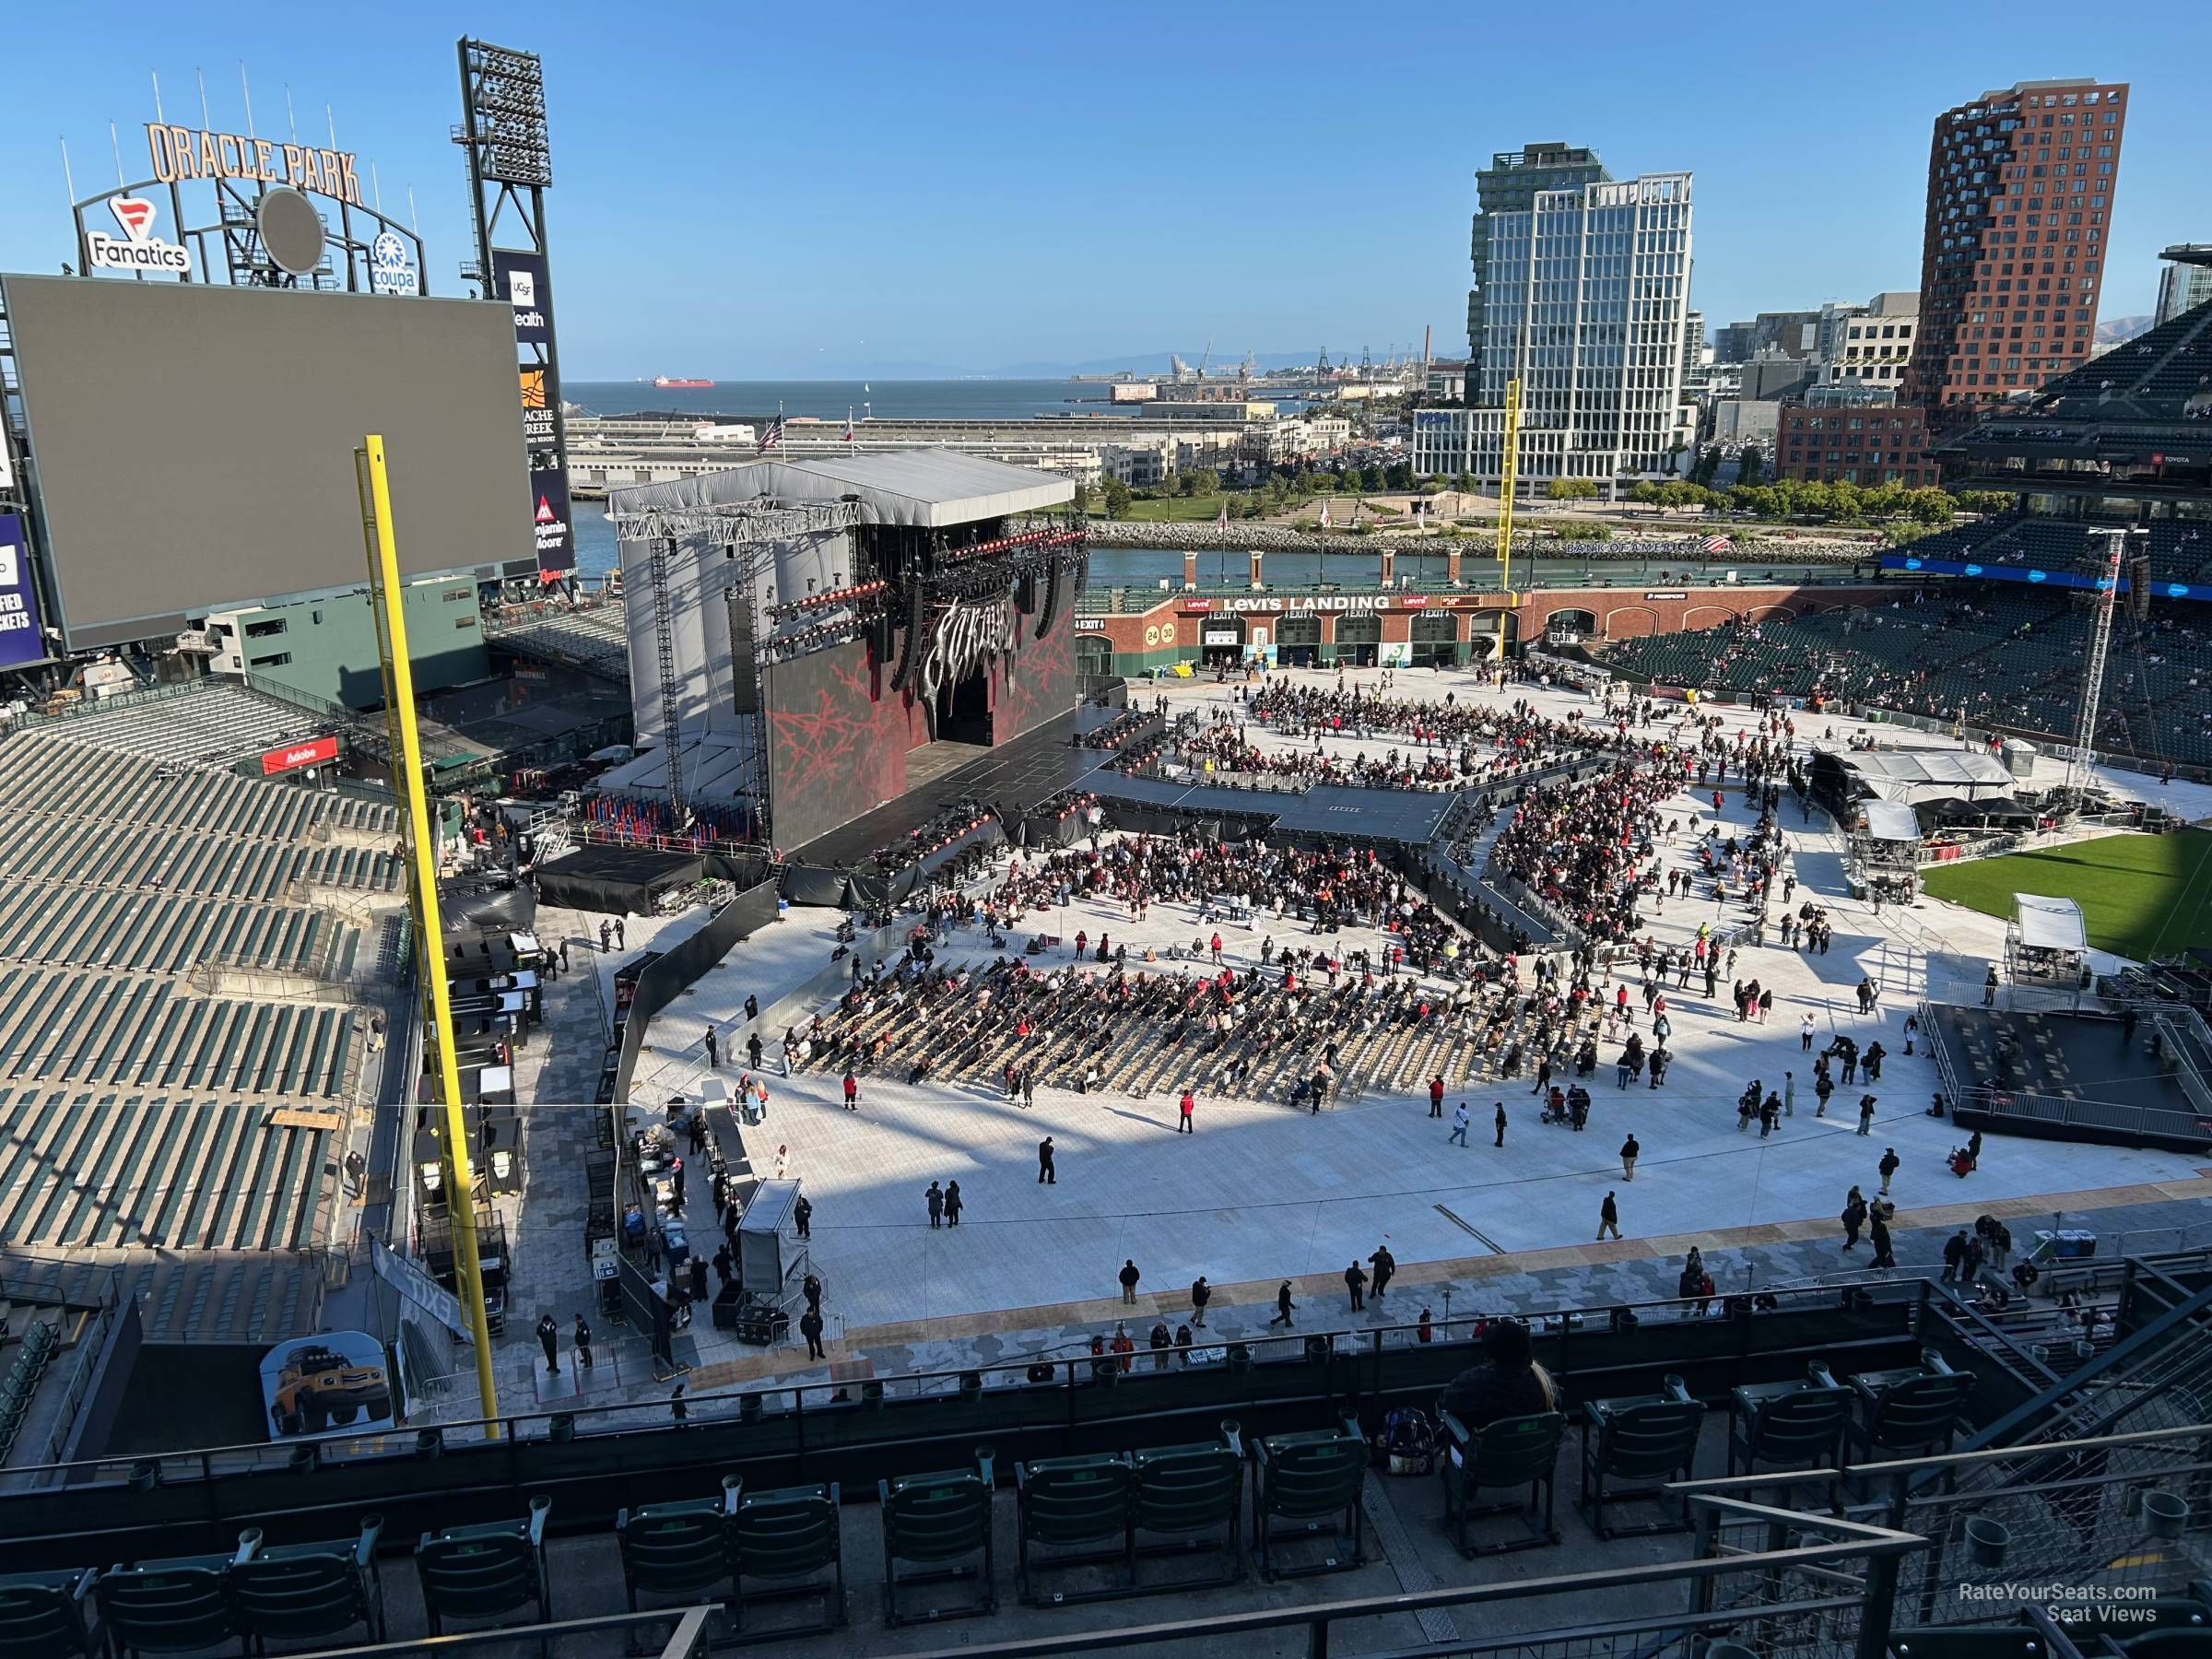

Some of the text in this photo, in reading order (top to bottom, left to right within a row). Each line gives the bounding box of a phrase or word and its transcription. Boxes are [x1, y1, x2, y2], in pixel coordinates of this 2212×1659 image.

[147, 124, 363, 207] ORACLE PARK
[93, 237, 185, 266] Fanatics
[372, 271, 414, 291] coupa
[513, 281, 531, 295] UCSF
[514, 311, 544, 326] ealth
[524, 410, 554, 421] ACHE
[1567, 542, 1696, 553] BANK OF AMERICA
[0, 594, 23, 612] FIED
[1223, 596, 1390, 611] Levi's LANDING
[1214, 611, 1232, 619] EXIT
[1290, 610, 1308, 618] EXIT
[1350, 609, 1369, 618] EXIT
[1426, 609, 1444, 618] EXIT
[1080, 619, 1100, 629] EXIT
[1147, 631, 1158, 641] 24
[1163, 629, 1172, 638] 30
[1551, 633, 1571, 642] BAR
[286, 748, 316, 764] Adobe
